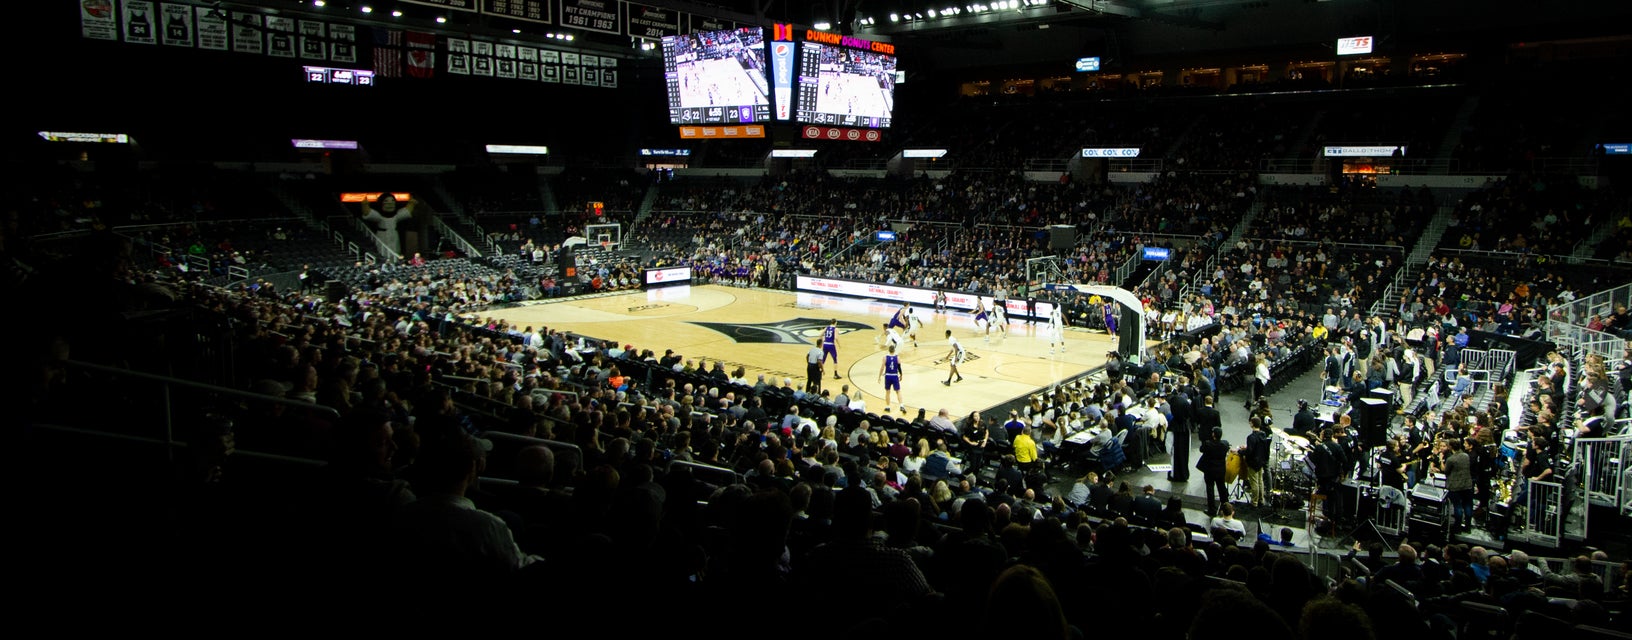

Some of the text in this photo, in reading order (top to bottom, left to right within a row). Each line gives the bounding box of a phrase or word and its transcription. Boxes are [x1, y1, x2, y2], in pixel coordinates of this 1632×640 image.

[565, 5, 616, 20] NIT CHAMPIONS
[568, 15, 613, 30] 1961 1963
[133, 26, 145, 34] 24
[646, 27, 664, 37] 2014
[807, 29, 895, 54] DUNKIN' DONUTS CENTER
[311, 73, 323, 81] 22
[359, 77, 370, 85] 23
[692, 111, 700, 119] 22
[729, 110, 738, 119] 23
[826, 330, 833, 338] 15
[889, 361, 895, 370] 4
